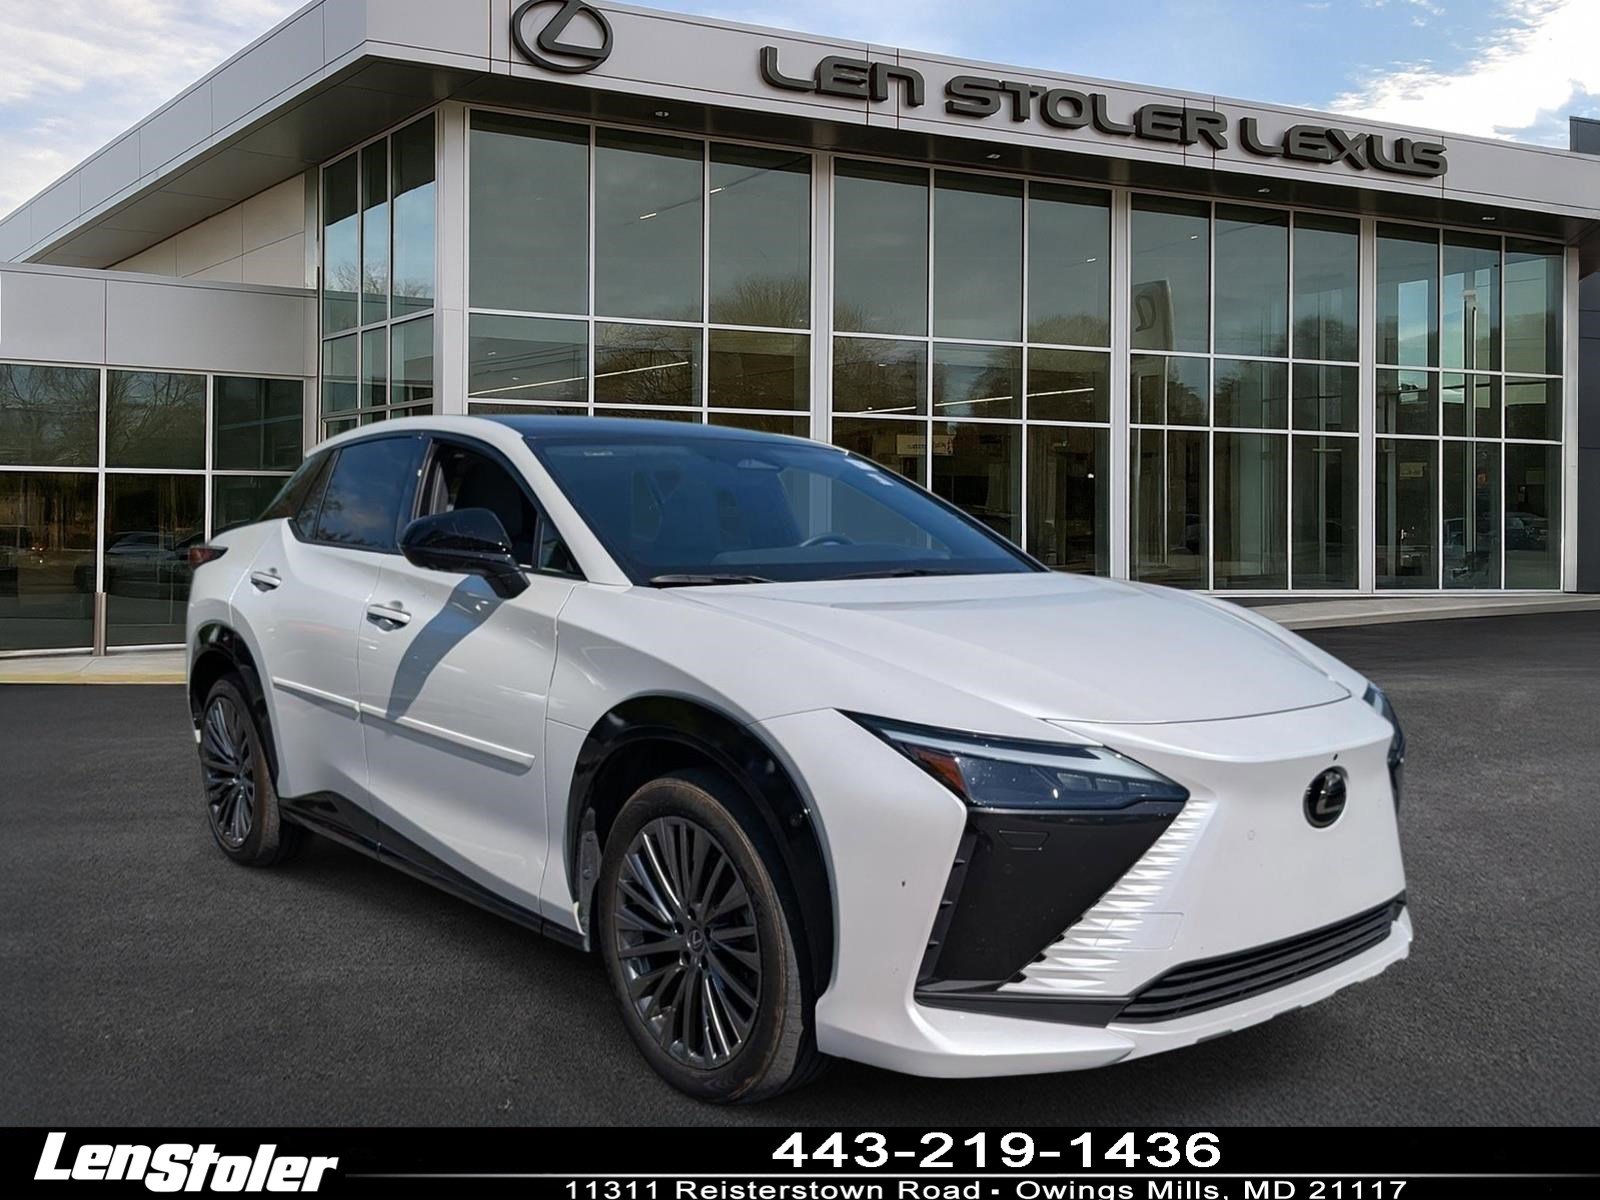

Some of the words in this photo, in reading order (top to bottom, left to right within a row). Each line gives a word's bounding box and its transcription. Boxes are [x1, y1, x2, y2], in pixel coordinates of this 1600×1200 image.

[760, 45, 925, 107] LEN
[945, 75, 1228, 150] STOLER
[1239, 116, 1448, 177] LEXUS
